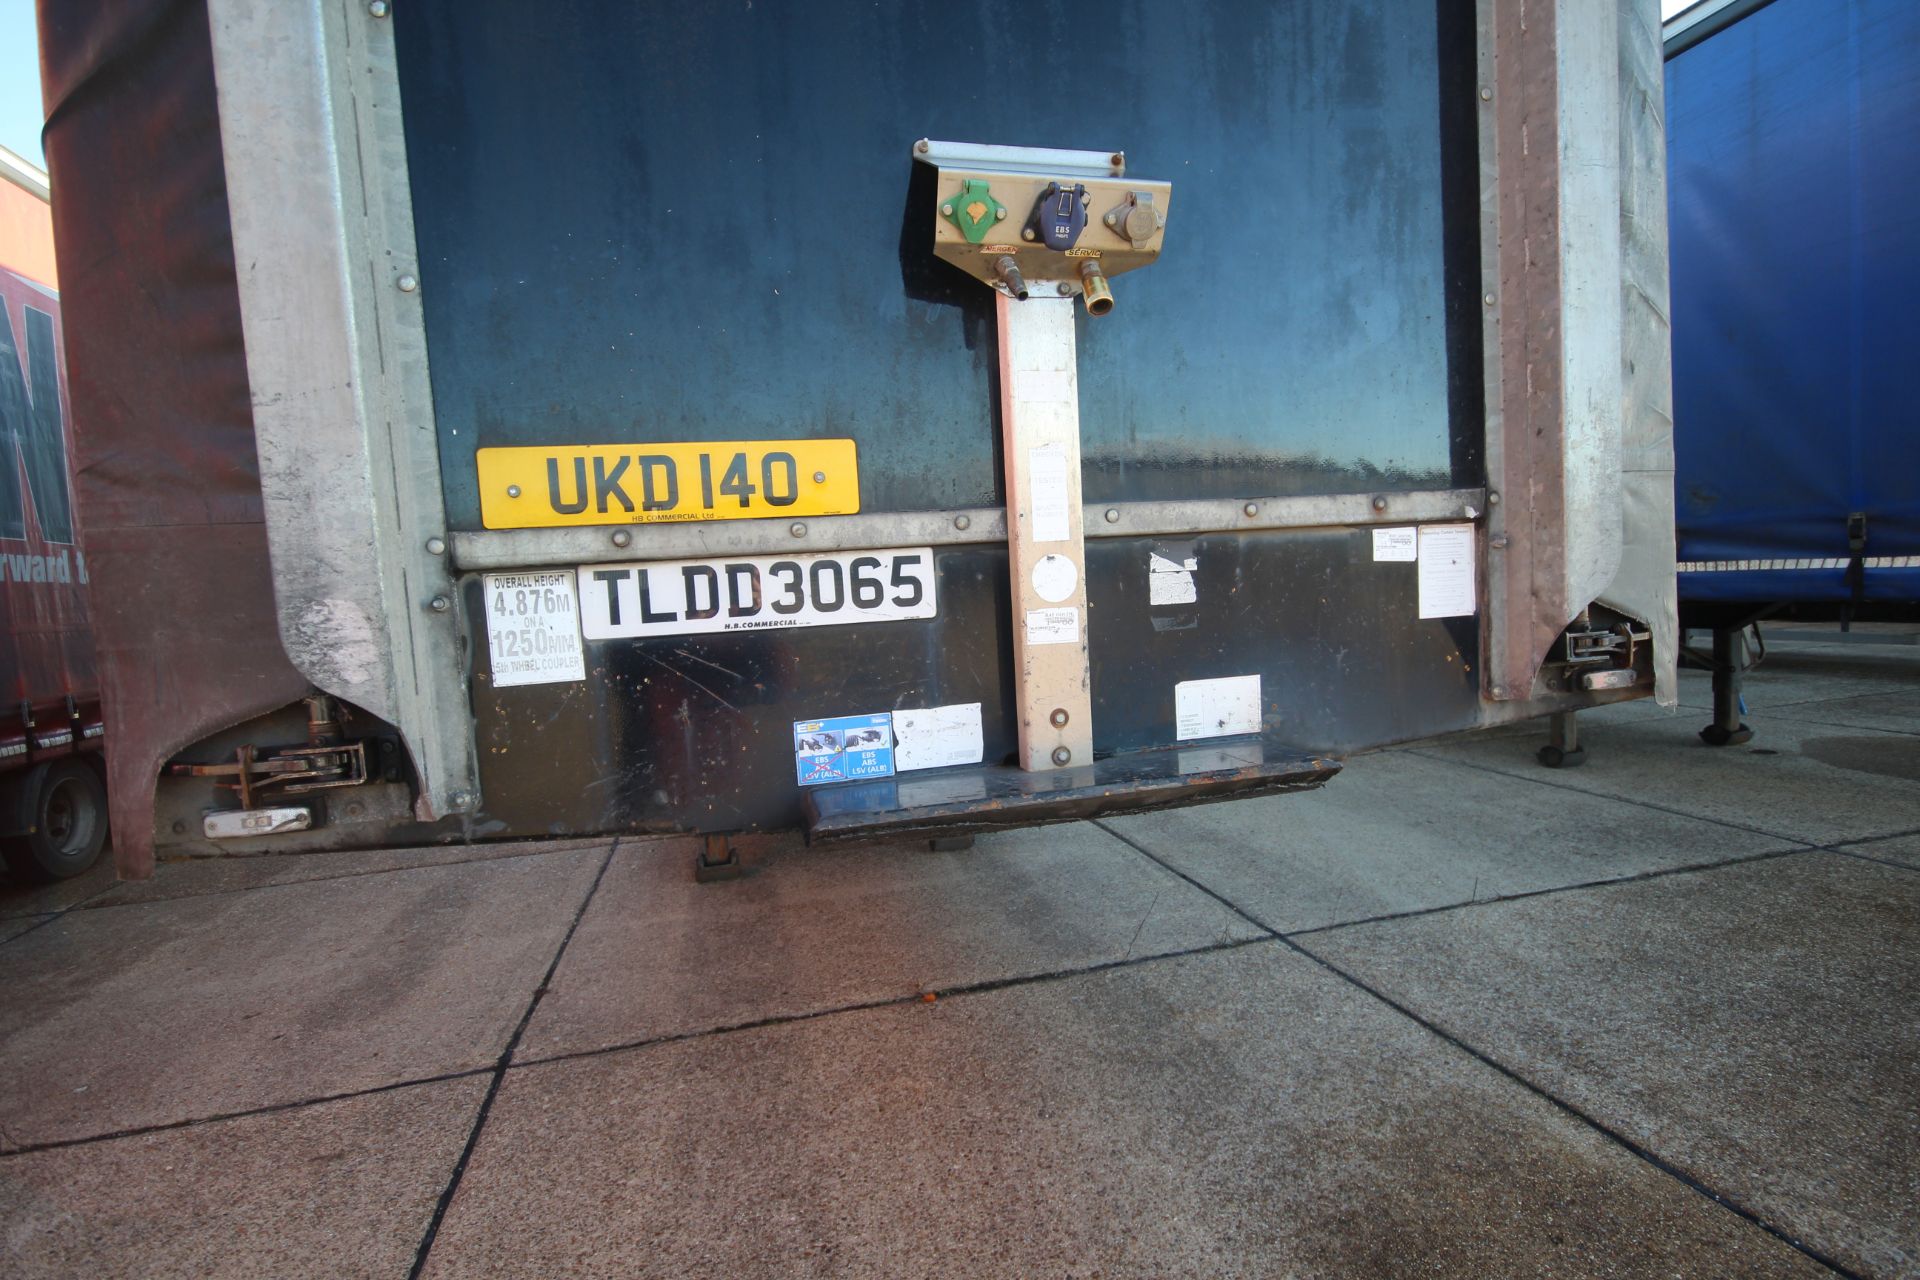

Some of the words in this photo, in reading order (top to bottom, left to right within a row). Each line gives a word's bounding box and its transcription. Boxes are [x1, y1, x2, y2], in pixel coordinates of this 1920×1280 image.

[1055, 225, 1070, 234] EBS
[546, 454, 679, 515] UKD
[699, 451, 799, 510] 140
[646, 513, 700, 522] COMMERCIAL
[494, 575, 532, 589] OVERALL
[534, 574, 565, 588] HEIGHT
[592, 555, 923, 625] TLDD3065
[494, 588, 570, 616] 4.876M
[523, 617, 536, 628] ON
[538, 616, 545, 628] A
[542, 655, 580, 670] COUPLER
[861, 751, 877, 759] EBS
